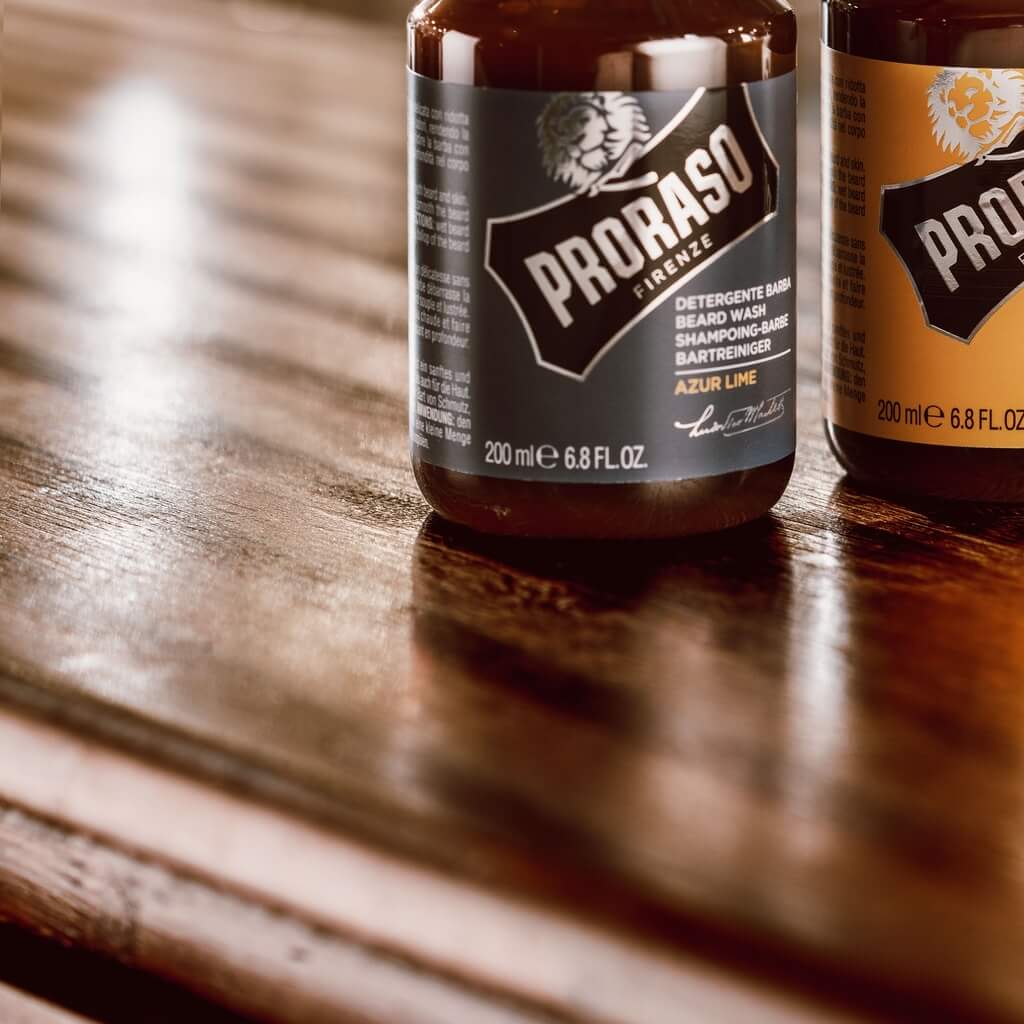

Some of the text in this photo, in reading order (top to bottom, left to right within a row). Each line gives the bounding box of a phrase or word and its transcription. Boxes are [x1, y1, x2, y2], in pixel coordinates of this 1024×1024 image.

[523, 123, 754, 328] PRORASO
[633, 232, 715, 299] FIRENZE
[675, 276, 792, 311] DETERGENTE BARBA
[675, 303, 766, 329] BEARD WASH
[675, 313, 789, 347] SHAMPOING-BARBE
[675, 339, 771, 366] BARTREINIGER
[674, 369, 757, 395] AZUR LIME
[877, 400, 901, 423] 200
[950, 407, 974, 430] 6.8
[485, 440, 512, 465] 200
[564, 446, 590, 470] 6.8
